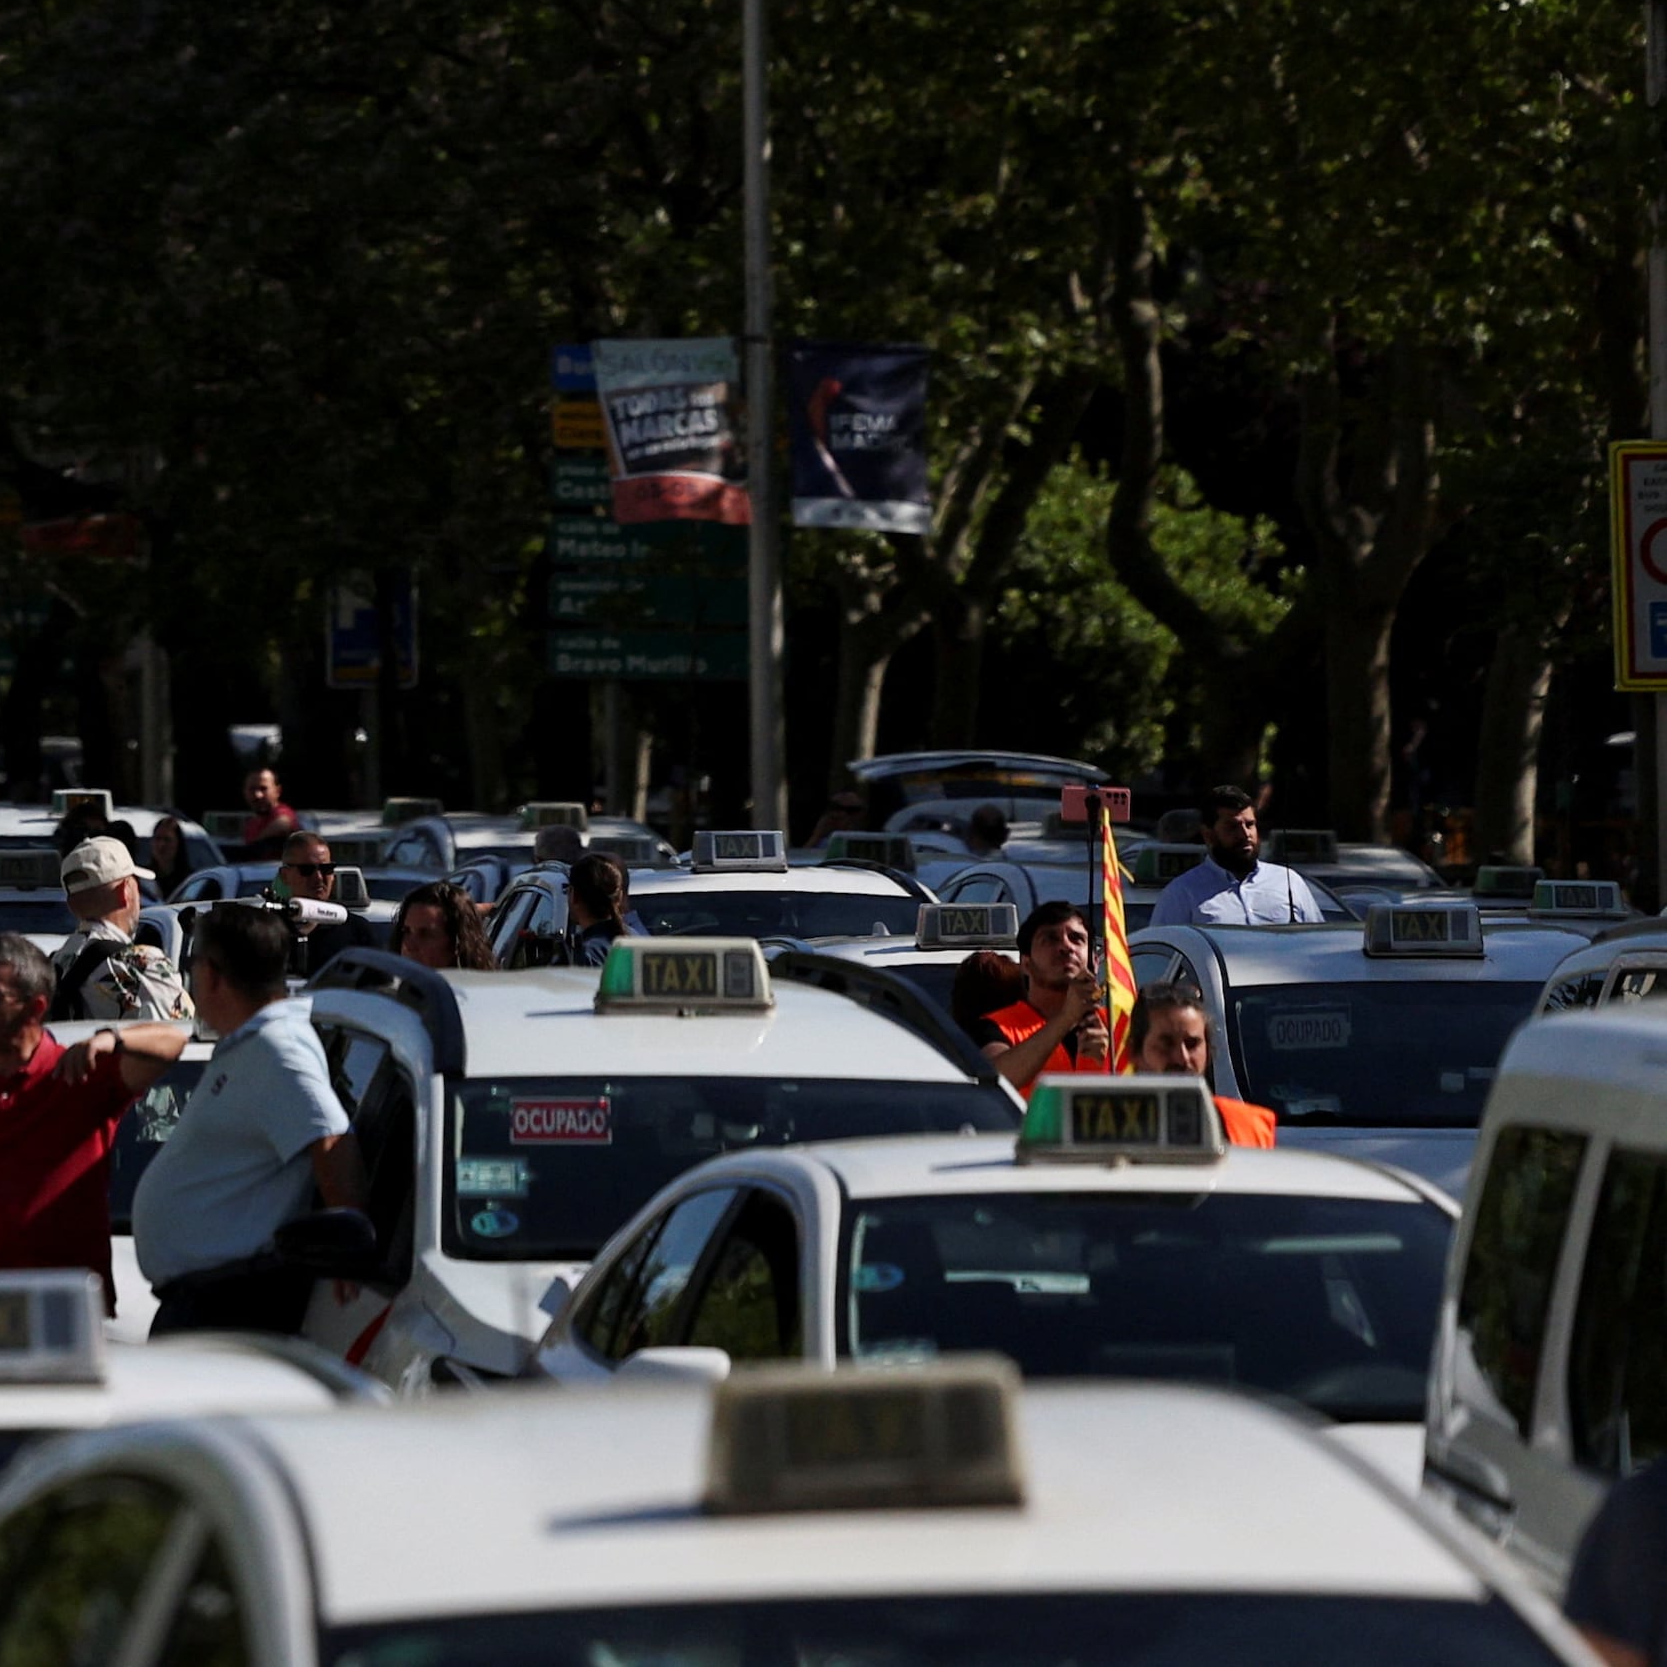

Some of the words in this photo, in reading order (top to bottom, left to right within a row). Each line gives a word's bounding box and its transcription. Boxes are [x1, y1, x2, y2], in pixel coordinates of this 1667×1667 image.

[942, 911, 986, 933] TAXI
[1395, 914, 1447, 940] TAXI
[645, 956, 715, 992] TAXI
[1277, 1017, 1341, 1044] OCUPADO
[515, 1107, 605, 1133] OCUPADO
[1075, 1098, 1157, 1137] TAXI
